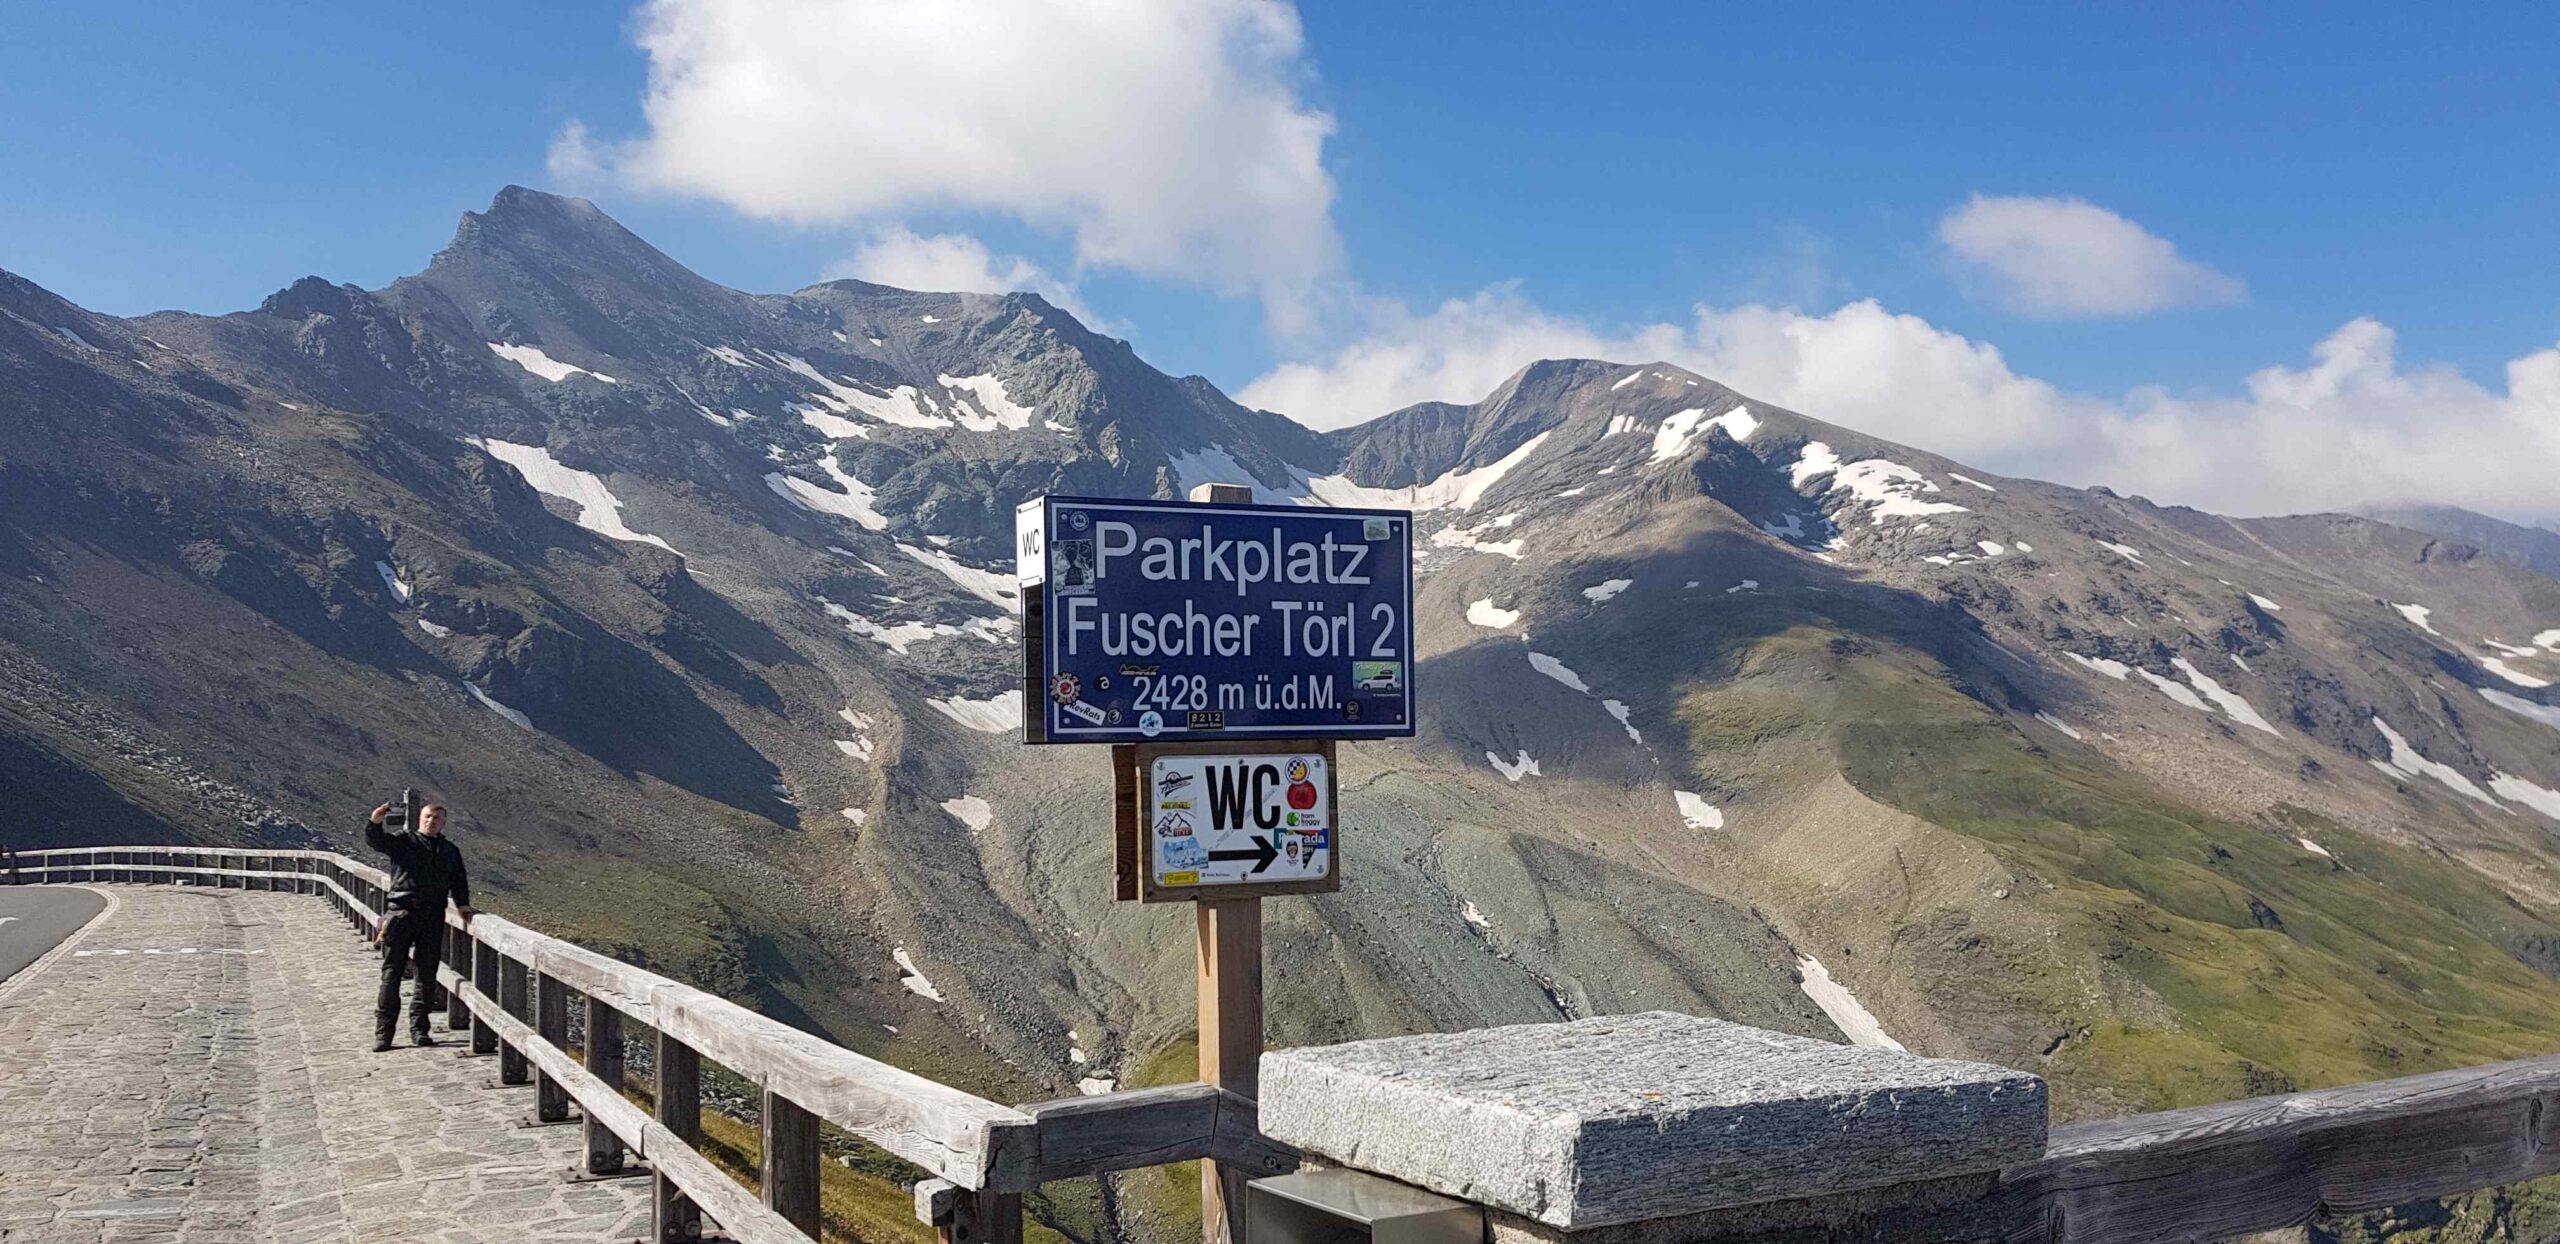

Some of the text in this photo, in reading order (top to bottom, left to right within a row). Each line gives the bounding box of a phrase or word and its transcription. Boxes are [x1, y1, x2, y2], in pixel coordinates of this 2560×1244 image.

[1022, 527, 1041, 557] WC
[1095, 520, 1371, 597] Parkplatz
[1067, 597, 1396, 657] Fuscher Törl 2
[1132, 675, 1207, 711] 2428
[1218, 683, 1244, 711] m
[1255, 675, 1342, 711] ü.d.M.
[1191, 712, 1221, 722] 8212
[1205, 764, 1281, 830] WC
